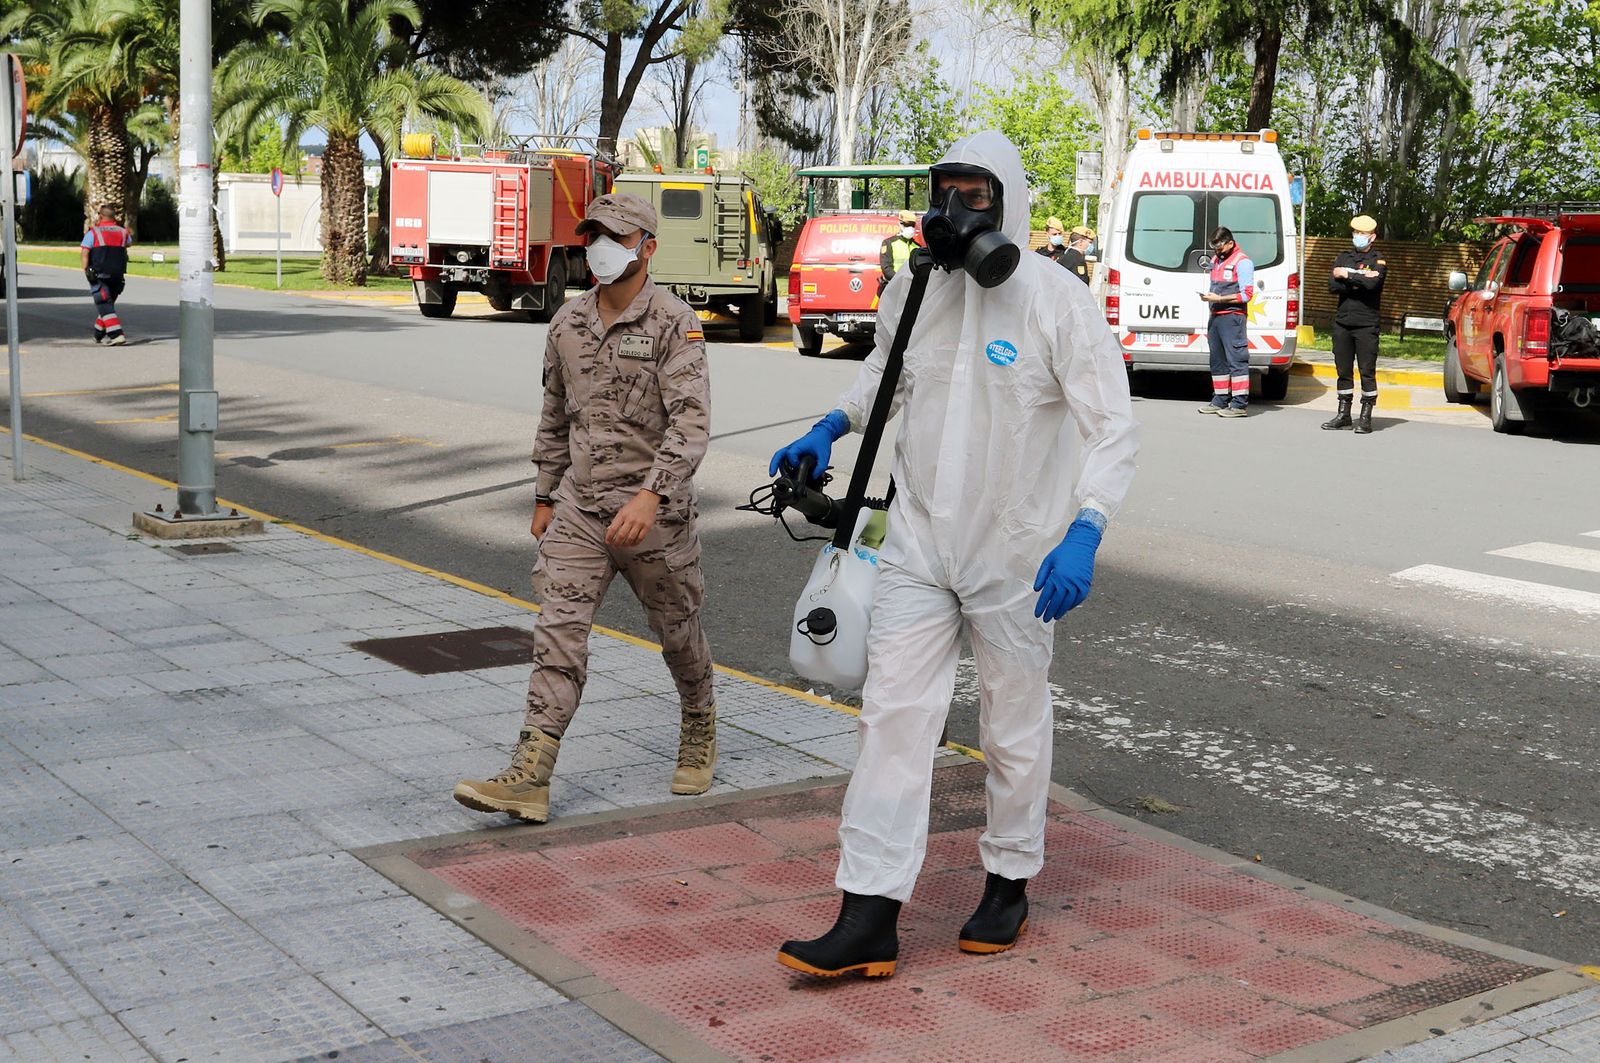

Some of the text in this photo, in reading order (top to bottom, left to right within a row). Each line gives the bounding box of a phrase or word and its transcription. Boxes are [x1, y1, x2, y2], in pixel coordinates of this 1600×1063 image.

[1139, 171, 1274, 191] AMBULANCIA
[1138, 304, 1180, 320] UME
[1143, 334, 1152, 343] ET
